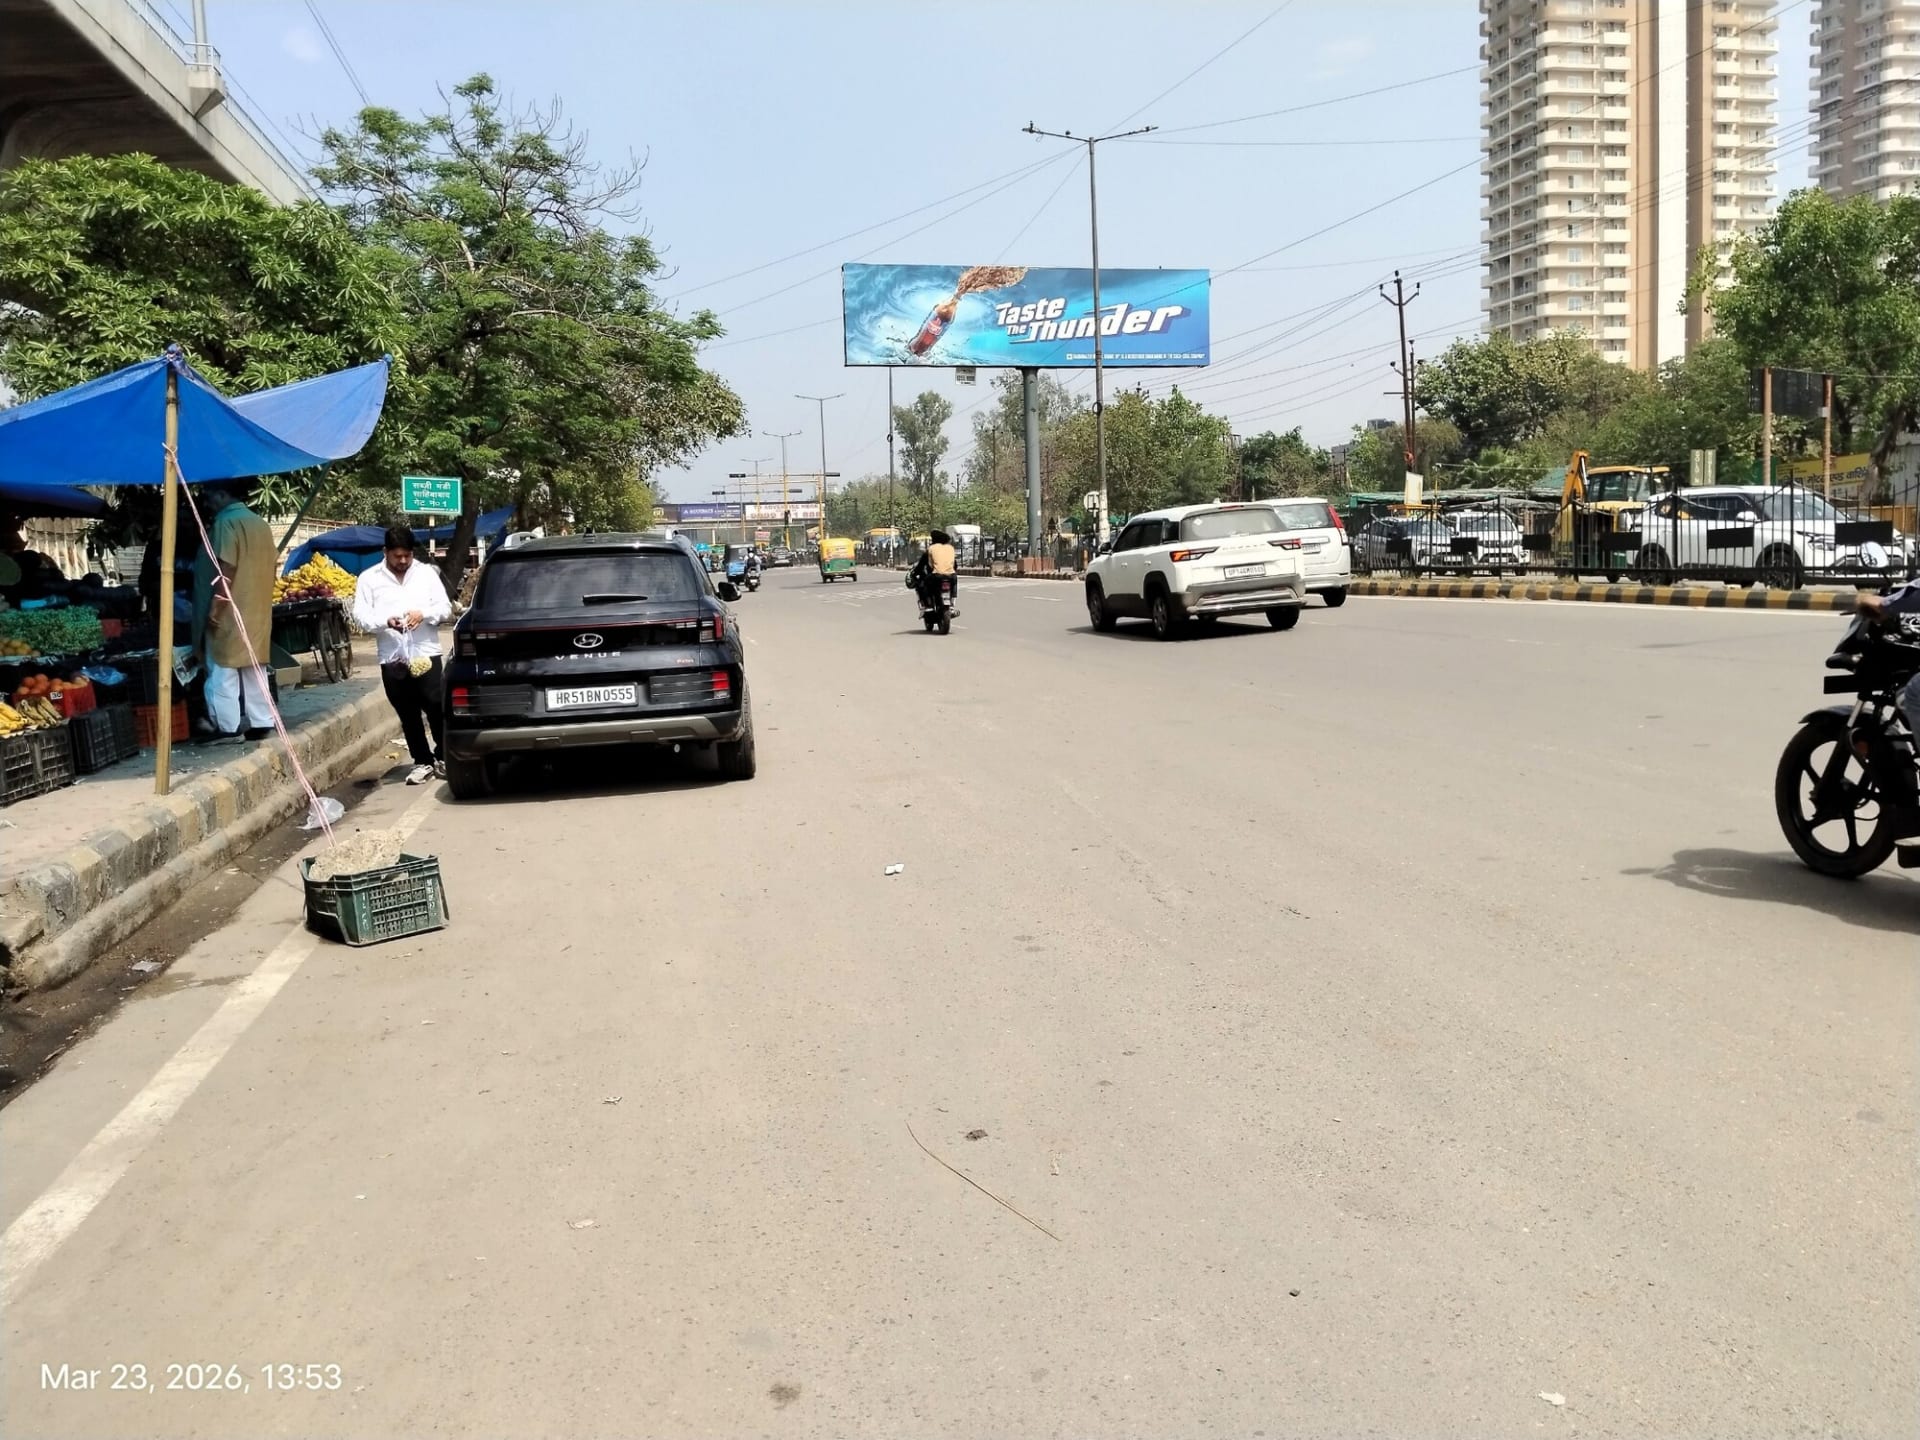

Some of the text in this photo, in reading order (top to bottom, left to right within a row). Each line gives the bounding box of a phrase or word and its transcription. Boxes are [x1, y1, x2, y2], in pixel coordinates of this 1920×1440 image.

[995, 297, 1066, 325] Taste
[1006, 303, 1183, 343] The Thunder
[555, 651, 621, 661] VENUE
[556, 687, 633, 704] HR51BN0555
